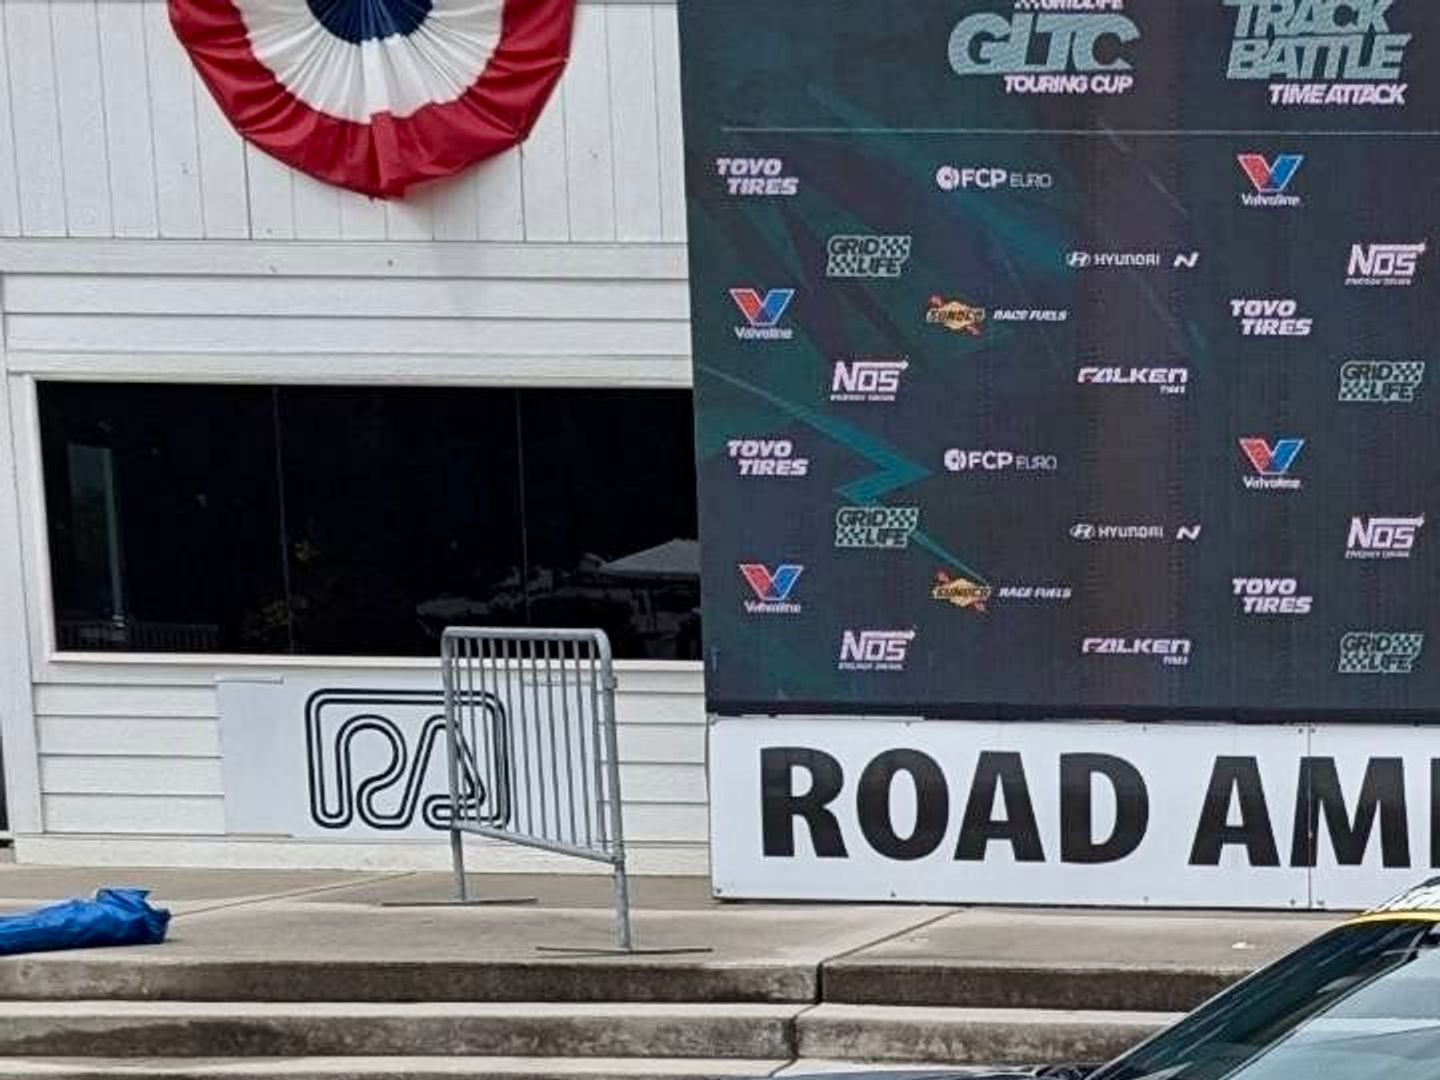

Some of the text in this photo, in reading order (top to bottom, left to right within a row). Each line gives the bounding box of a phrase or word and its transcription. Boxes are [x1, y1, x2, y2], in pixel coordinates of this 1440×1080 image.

[1222, 0, 1394, 37] TRACK
[948, 13, 1140, 75] GLTC
[1226, 34, 1412, 79] BATTLE
[1004, 75, 1133, 93] TOURING CUP
[716, 159, 782, 175] TOYO
[727, 177, 798, 196] TIRES
[962, 169, 1051, 188] FCP EURO
[1242, 194, 1301, 207] Valvoline
[829, 236, 880, 255] GRID
[855, 257, 901, 275] LIFE
[1095, 253, 1160, 267] HYUNDAI
[1347, 243, 1416, 277] NOS
[1231, 301, 1297, 317] TOYO
[734, 326, 793, 340] Valvoline
[1242, 319, 1313, 336] TIRES
[832, 361, 903, 393] NOS
[1078, 367, 1188, 384] FALKEN
[1342, 363, 1393, 381] GRID
[1370, 382, 1417, 400] LIFE
[727, 441, 792, 457] TOYO
[738, 459, 808, 476] TIRES
[967, 452, 1057, 471] FCP EURO
[1243, 477, 1302, 489] Valvoline
[838, 508, 888, 527] GRID
[864, 529, 909, 547] LIFE
[1098, 525, 1164, 538] HYUNDAI
[1347, 517, 1416, 549] NOS
[1233, 579, 1298, 595] TOYO
[743, 601, 802, 614] Valvoline
[1243, 597, 1314, 614] TIRES
[841, 630, 908, 661] NOS
[1082, 638, 1192, 655] FALKEN
[1342, 633, 1392, 651] GRID
[1370, 652, 1415, 671] LIFE
[760, 747, 1149, 866] ROAD
